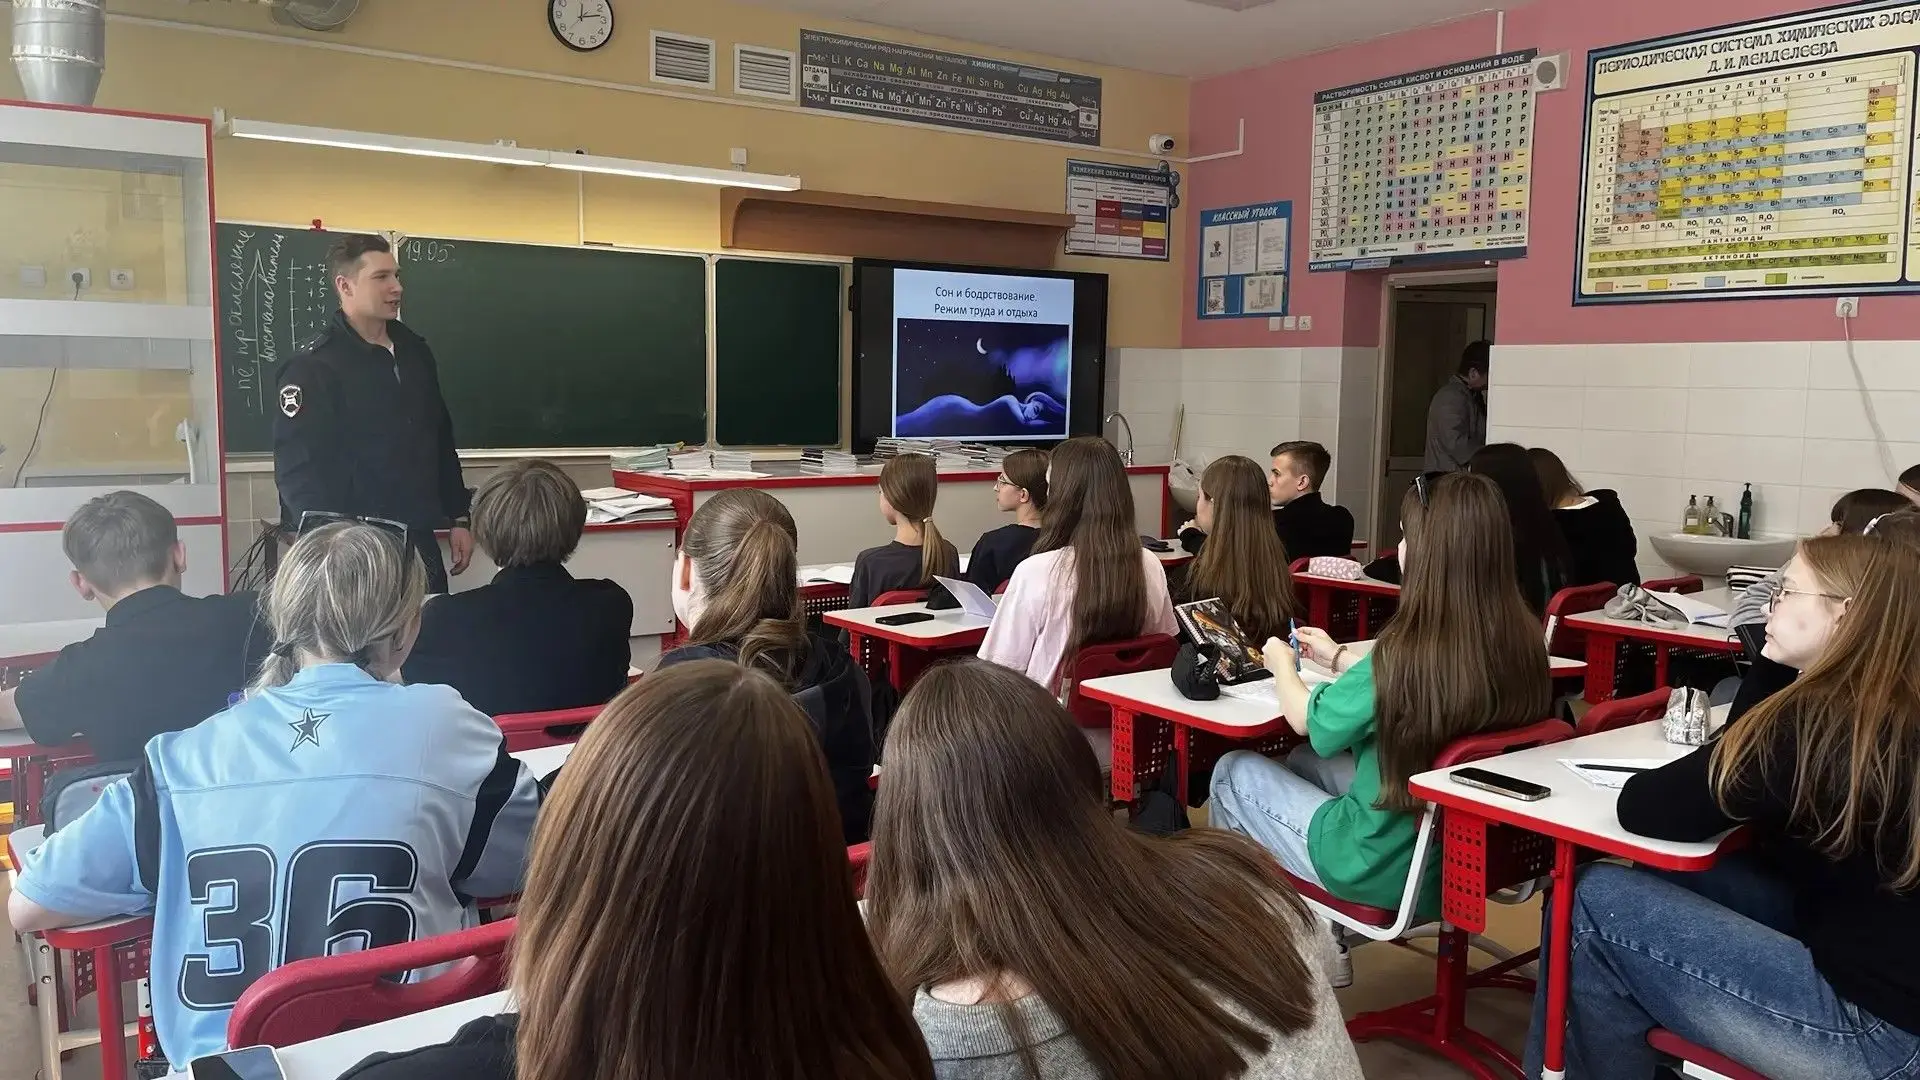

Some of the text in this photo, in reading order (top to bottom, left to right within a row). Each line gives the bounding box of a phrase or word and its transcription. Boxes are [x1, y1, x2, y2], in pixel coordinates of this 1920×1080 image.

[597, 4, 603, 12] 2
[560, 23, 566, 31] 8
[600, 16, 607, 24] 3
[1599, 45, 1707, 74] ПЕРИОДИЧЕСКАЯ
[1711, 34, 1773, 54] СИСТЕМА
[1777, 16, 1875, 43] ХИМИЧЕСКИХ
[1707, 41, 1838, 73] Д. И. МЕНДЕЛЕЕВА
[804, 66, 827, 74] ОТДАЧА
[971, 60, 996, 70] ХИМИЯ
[832, 54, 840, 64] Li
[845, 56, 852, 66] K
[857, 58, 868, 68] Ca
[874, 61, 884, 71] Na
[890, 63, 902, 75] Mg
[907, 66, 916, 75] Al
[921, 68, 932, 78] Mn
[937, 70, 947, 80] Zn
[952, 73, 962, 82] Fe
[966, 76, 974, 84] Ni
[979, 77, 990, 87] Sn
[994, 80, 1004, 89] Pb
[1018, 84, 1028, 93] Cu
[1032, 86, 1042, 97] Ag
[1046, 88, 1056, 99] Hg
[1060, 91, 1070, 100] Au
[1322, 84, 1377, 100] РАСТВОРИМОСТЬ
[1406, 72, 1434, 84] КИСЛОТ
[1442, 60, 1492, 76] ОСНОВАНИЙ
[1502, 54, 1525, 64] ВОДЕ
[1656, 71, 1826, 102] ГРУППЫ ЭЛЕМЕНТОВ
[1212, 206, 1279, 222] КЛАССНЫЙ УГОЛОК
[1701, 236, 1763, 244] ЛАНТАНОИДЫ
[935, 287, 953, 297] Сон
[965, 288, 1037, 301] бодрствование.
[934, 303, 967, 314] Режим
[970, 307, 995, 317] труда
[1006, 310, 1038, 318] отдыха
[178, 840, 418, 1010] 36
